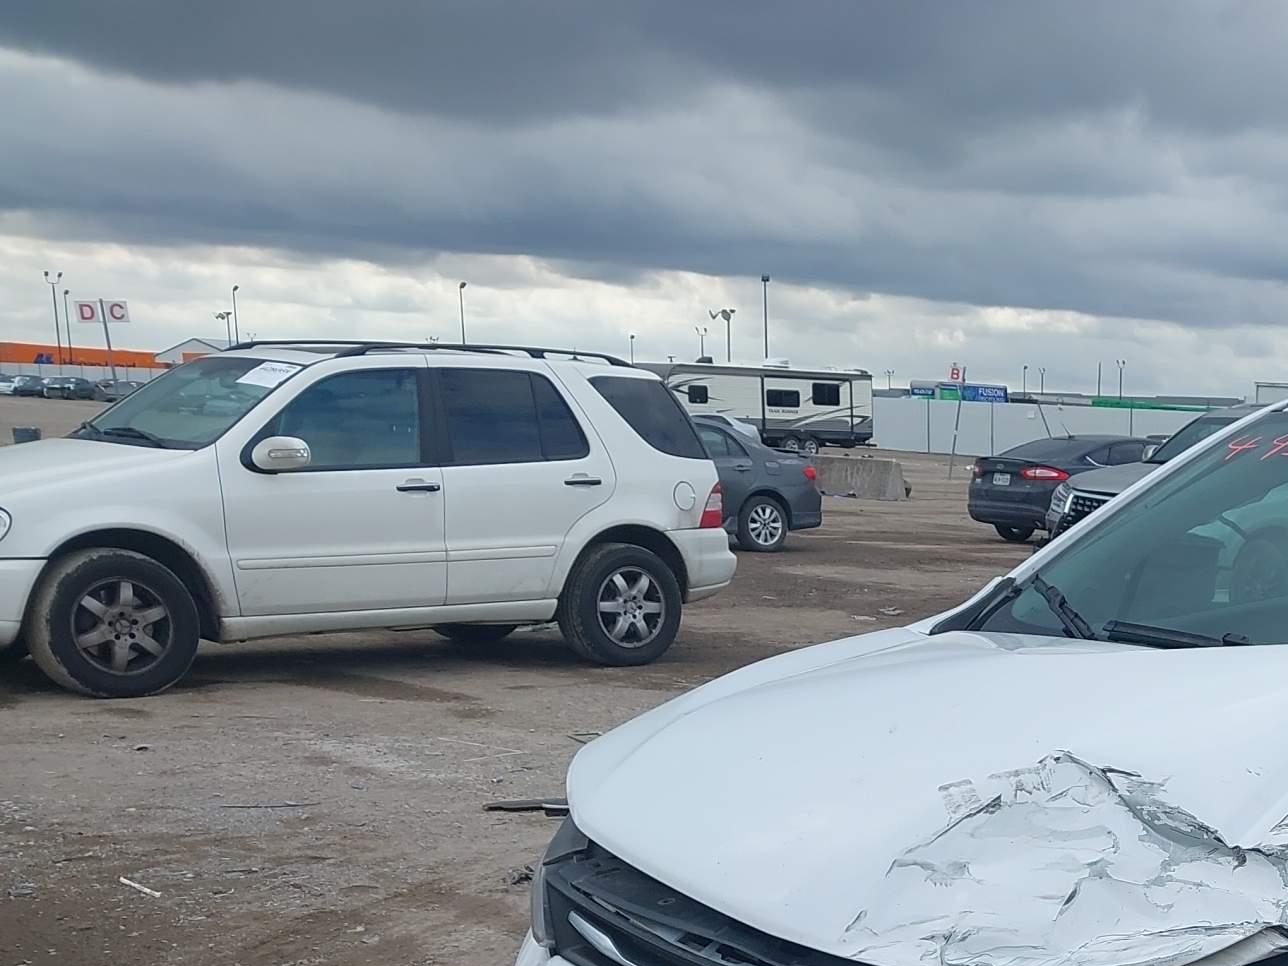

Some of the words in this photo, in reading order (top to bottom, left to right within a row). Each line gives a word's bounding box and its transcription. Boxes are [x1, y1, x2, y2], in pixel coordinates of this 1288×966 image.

[79, 304, 95, 320] D
[110, 303, 126, 320] C
[951, 368, 960, 380] B
[978, 387, 1004, 397] FUSION
